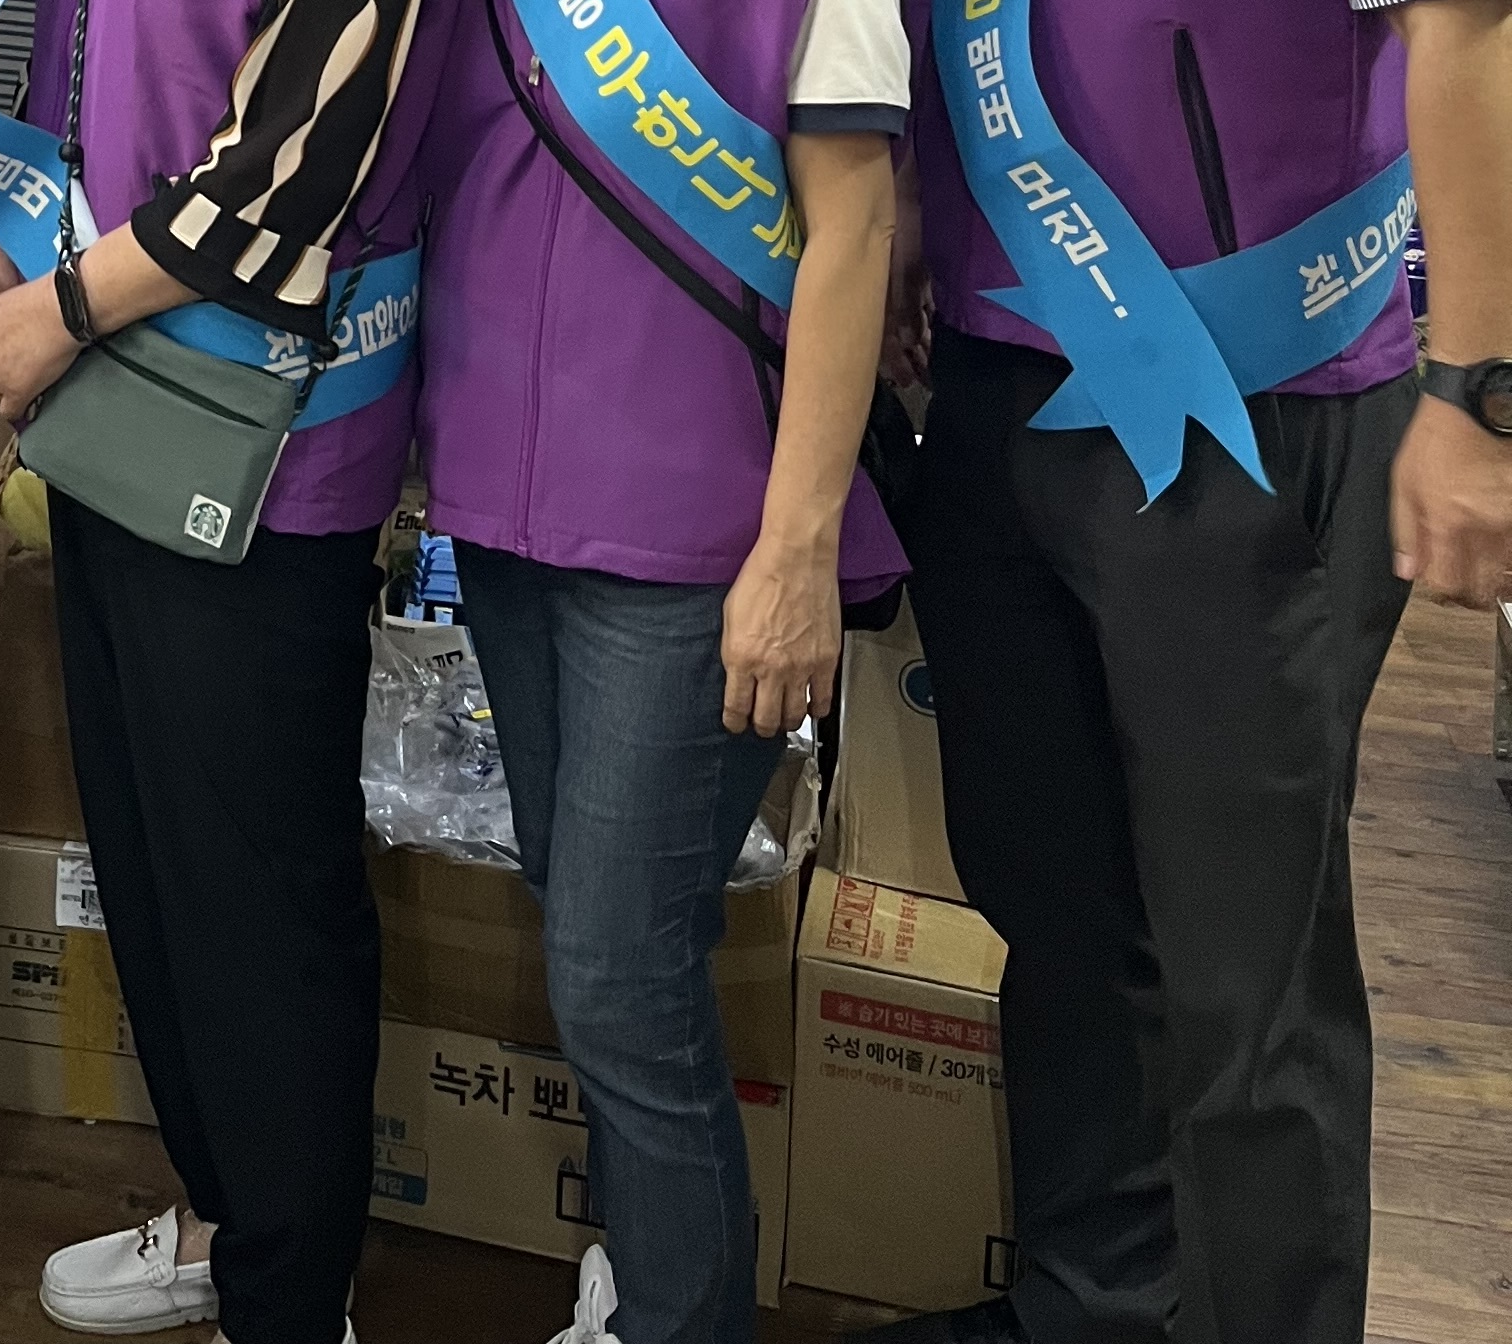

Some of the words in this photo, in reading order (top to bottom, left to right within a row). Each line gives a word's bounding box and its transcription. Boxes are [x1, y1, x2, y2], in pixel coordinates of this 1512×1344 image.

[966, 27, 1024, 140] 멤버
[1006, 160, 1129, 319] 모집!
[823, 1033, 861, 1060] 수성
[429, 1051, 515, 1117] 녹차
